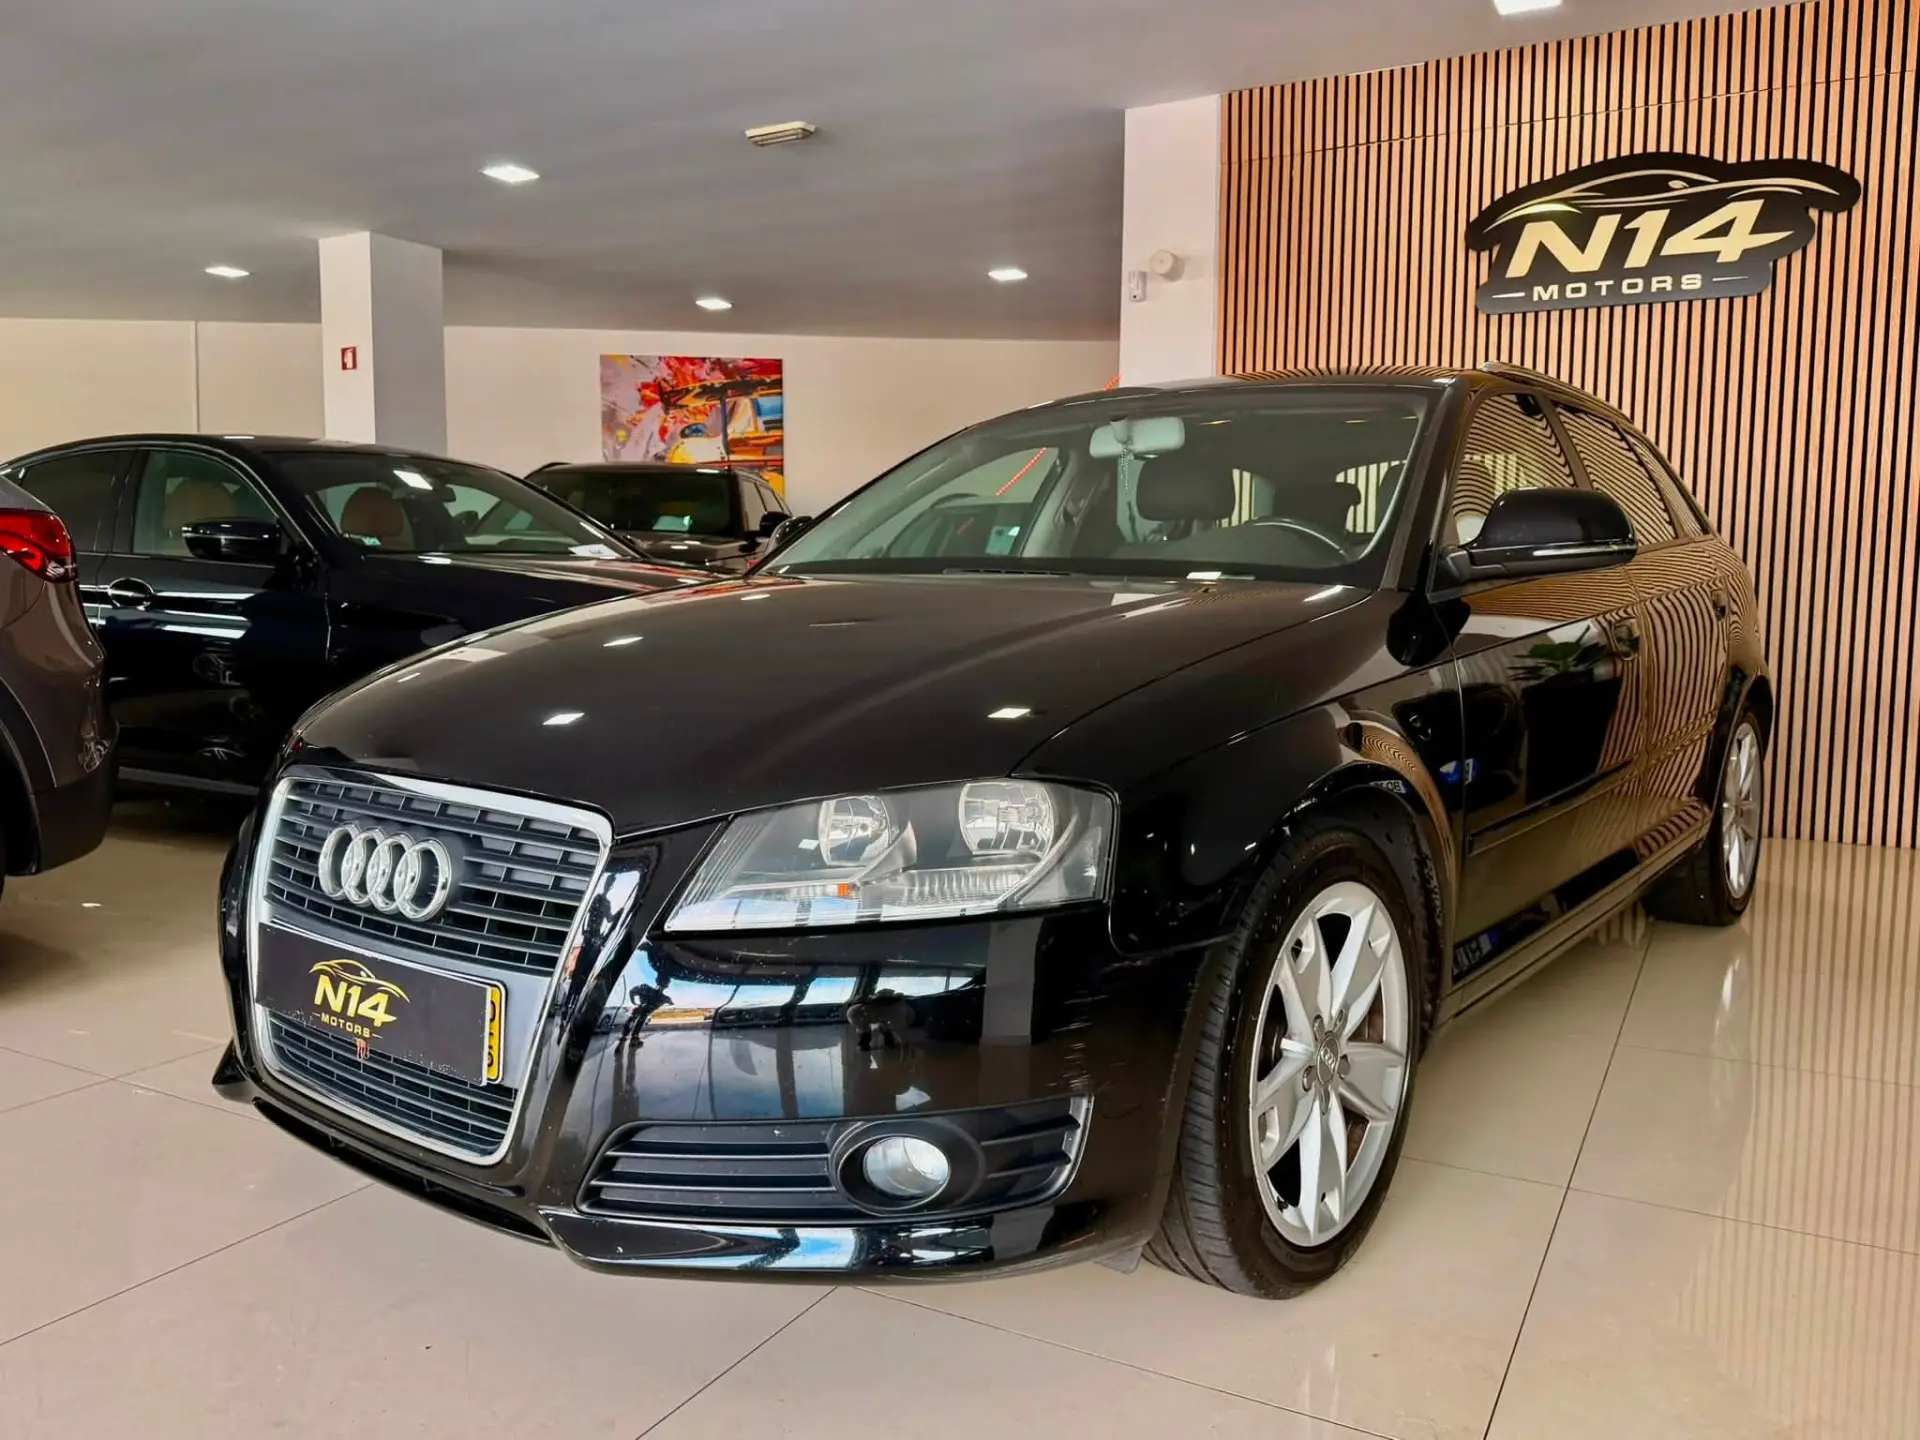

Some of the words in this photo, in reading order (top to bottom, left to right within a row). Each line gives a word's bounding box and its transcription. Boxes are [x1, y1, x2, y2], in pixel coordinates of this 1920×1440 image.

[1505, 199, 1794, 278] N14
[1533, 273, 1702, 301] MOTORS
[314, 975, 397, 1027] N14
[321, 1013, 371, 1038] MOTORS
